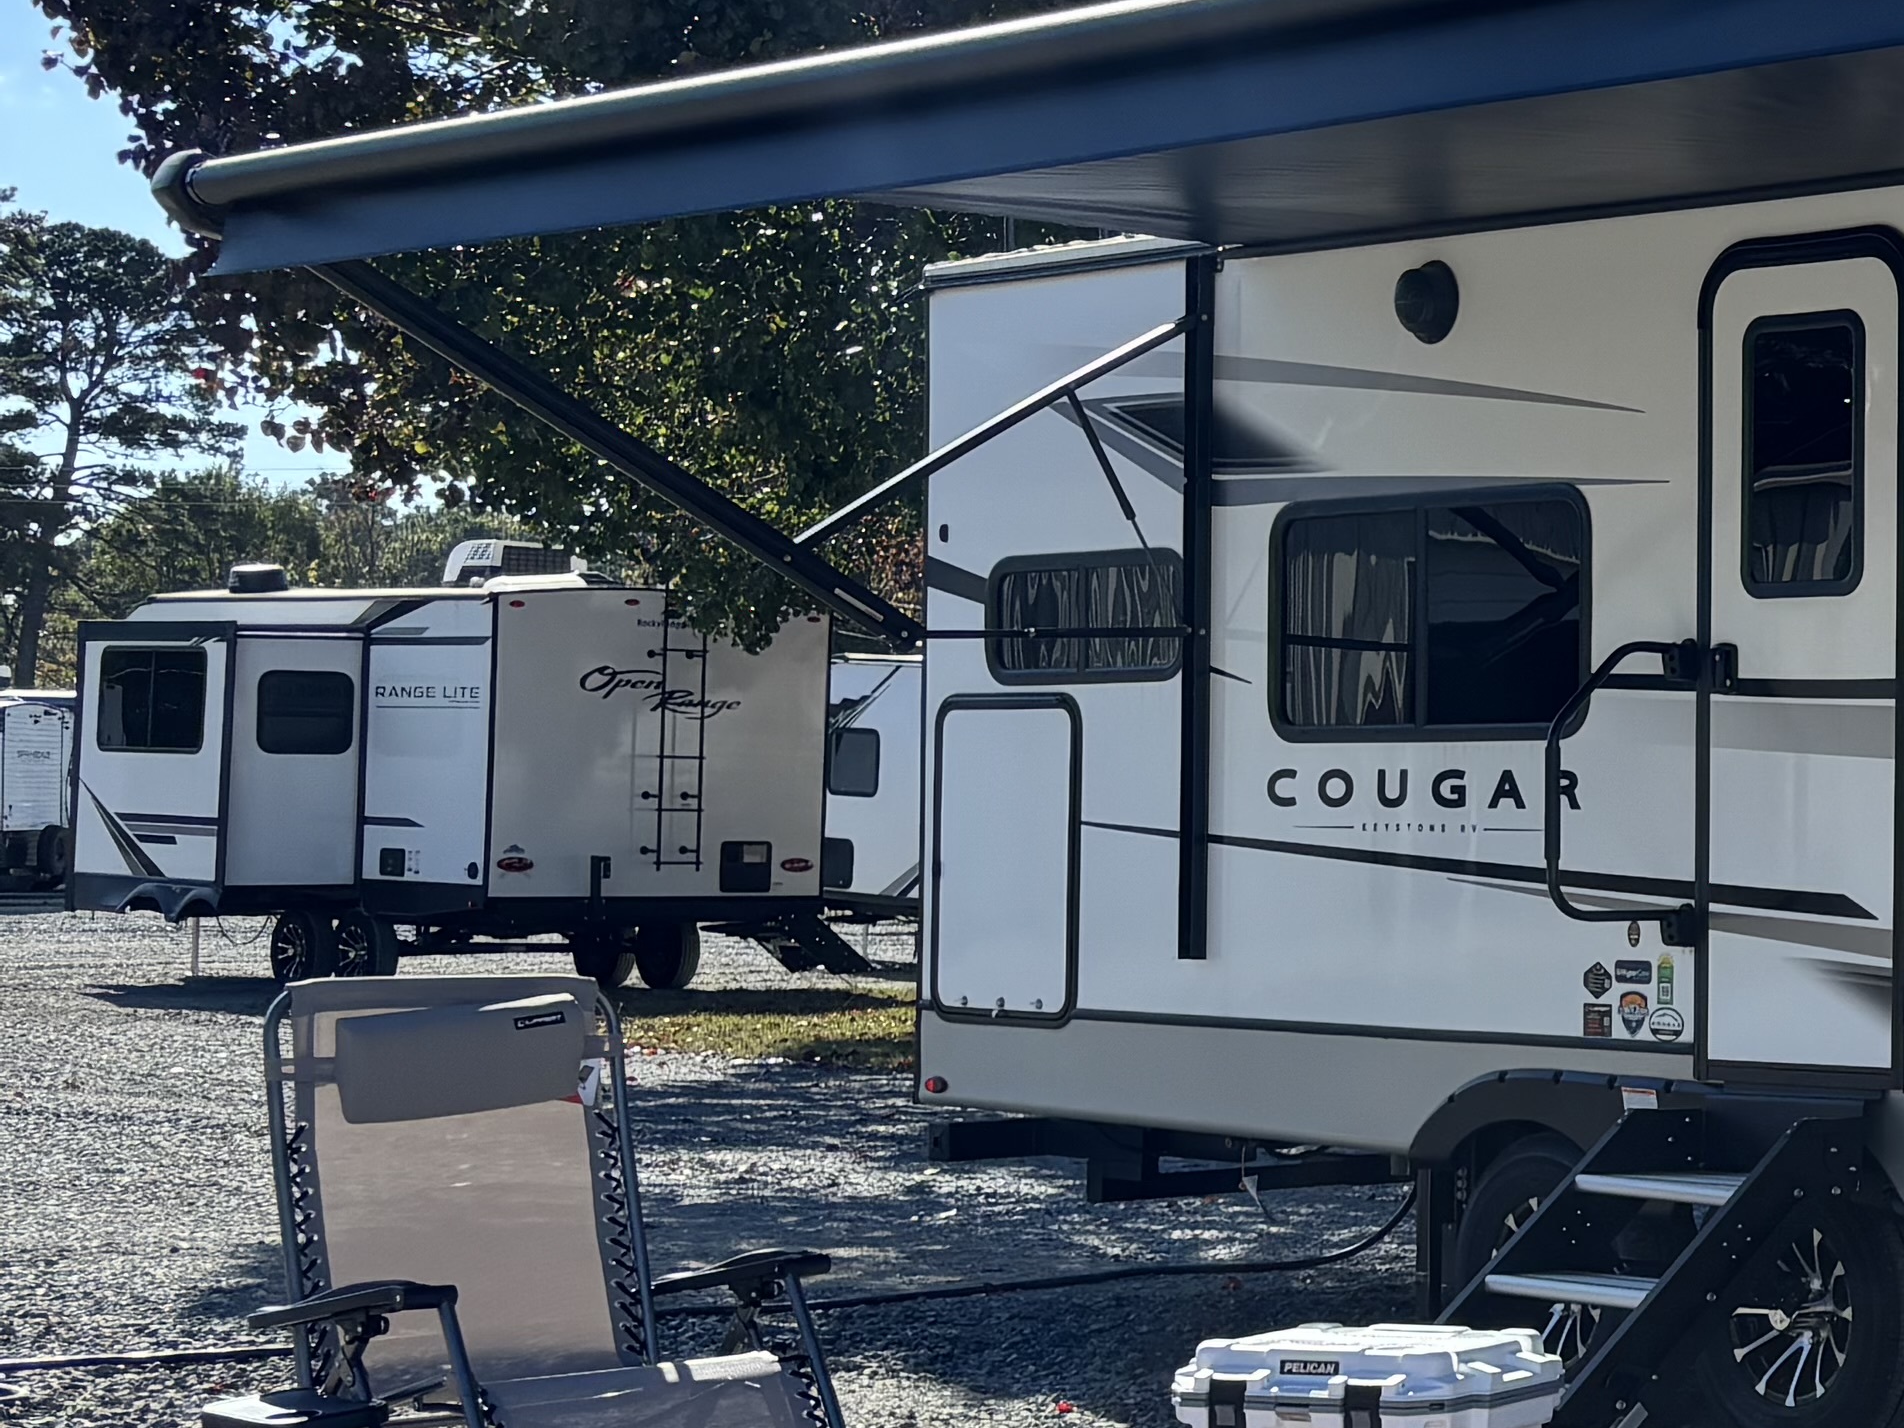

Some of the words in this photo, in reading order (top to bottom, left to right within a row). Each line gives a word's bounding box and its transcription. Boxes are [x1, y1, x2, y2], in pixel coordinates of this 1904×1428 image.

[375, 685, 437, 699] RANGE
[443, 685, 480, 699] LITE
[579, 664, 667, 699] Open
[643, 689, 742, 720] Range
[1267, 768, 1582, 810] COUGAR
[1362, 823, 1446, 833] KEYSTONE
[1284, 1361, 1336, 1374] PELICAN
